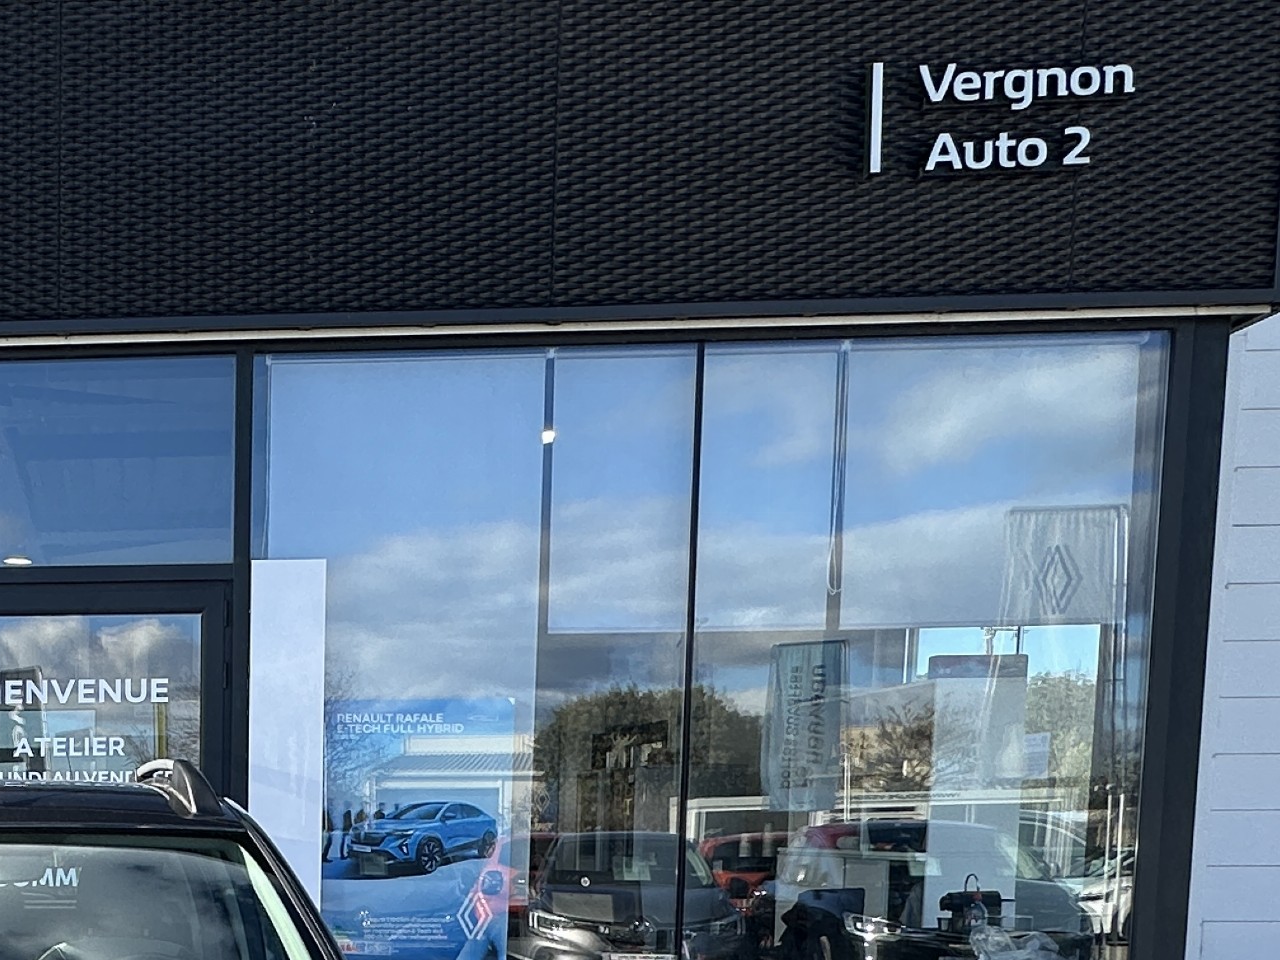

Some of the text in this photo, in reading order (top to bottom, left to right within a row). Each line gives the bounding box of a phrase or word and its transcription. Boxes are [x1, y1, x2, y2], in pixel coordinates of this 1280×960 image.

[919, 63, 1135, 110] Vergnon
[925, 126, 1091, 171] Auto 2
[337, 713, 444, 723] RENAULT RAFALE
[337, 724, 465, 734] E-TECH FULL HYBRID
[13, 737, 125, 757] ATELIER
